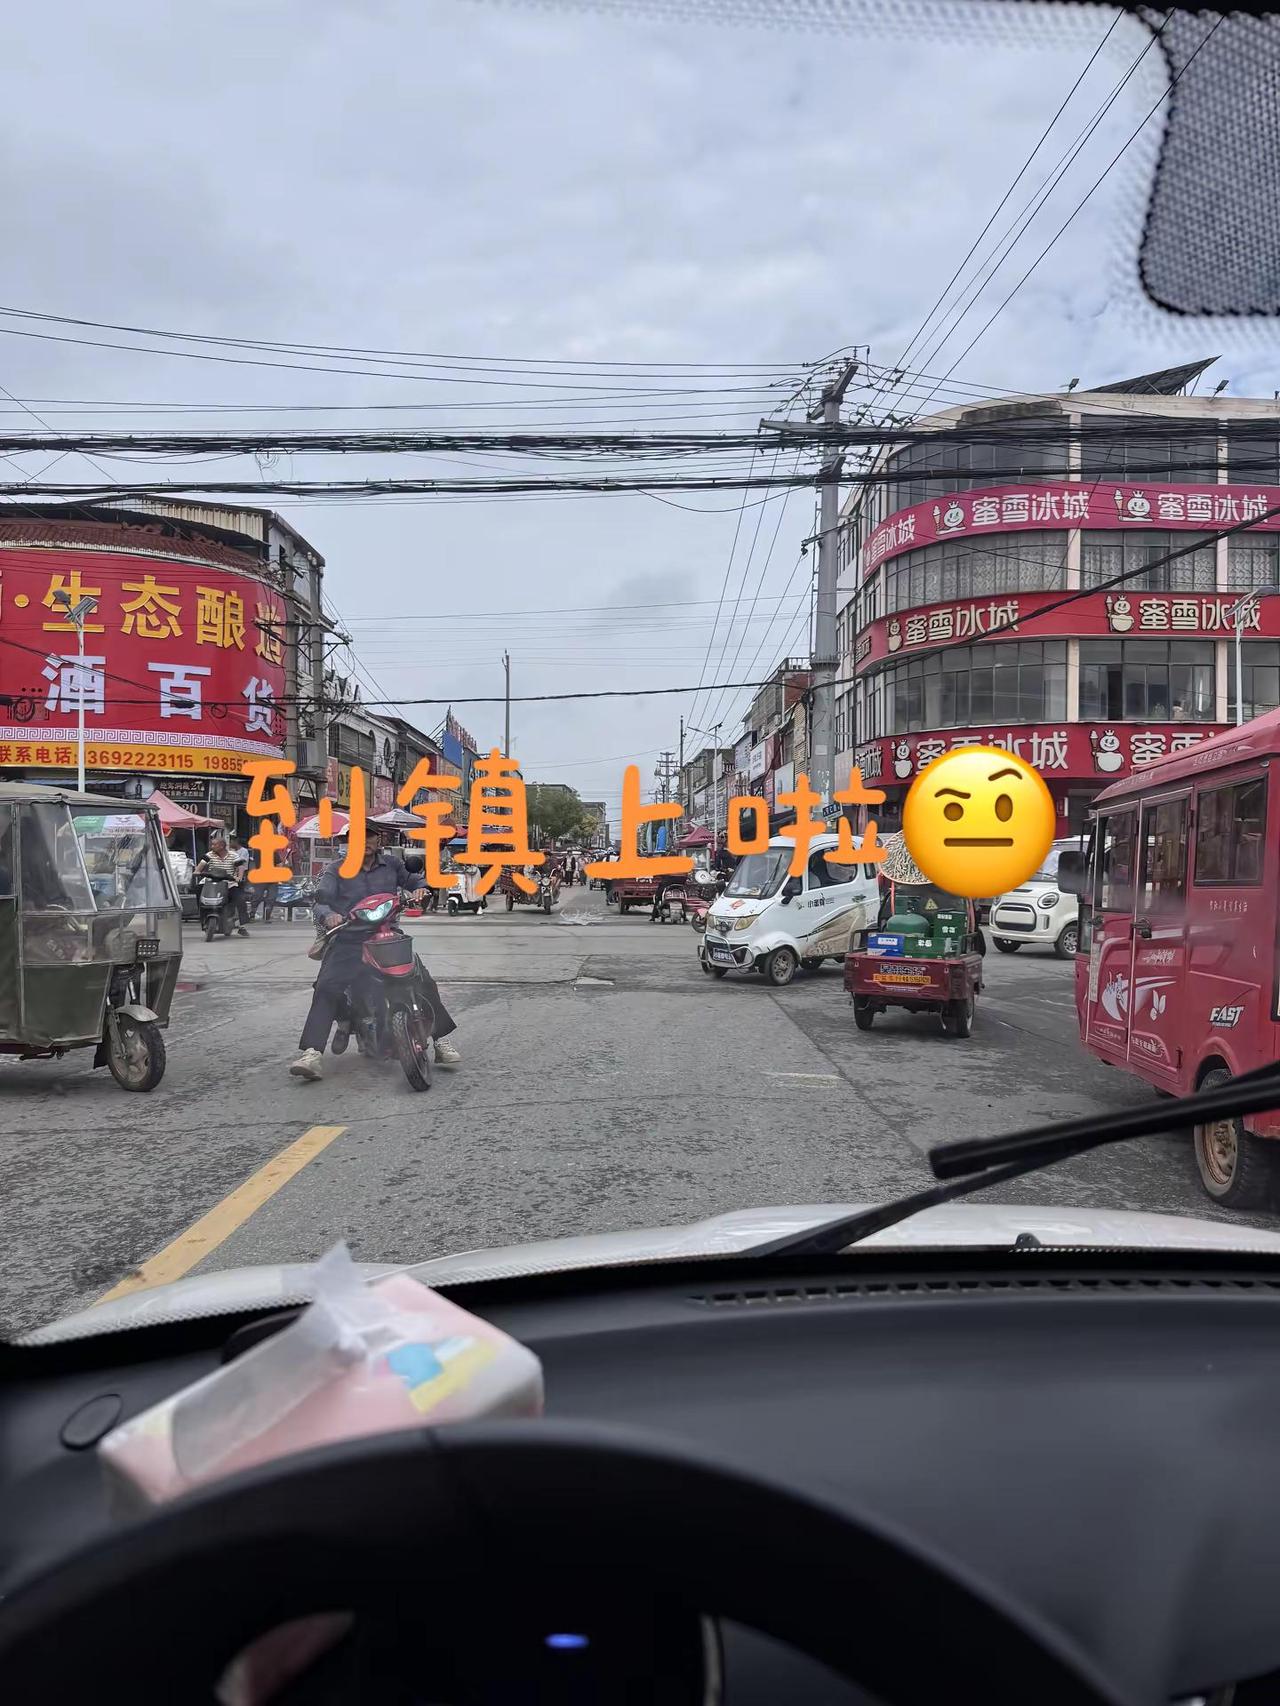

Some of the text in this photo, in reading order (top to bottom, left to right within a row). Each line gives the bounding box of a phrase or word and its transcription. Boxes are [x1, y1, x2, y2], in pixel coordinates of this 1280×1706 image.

[972, 490, 1090, 526] 蜜雪冰城
[1158, 492, 1268, 523] 蜜雪冰城
[904, 600, 1019, 645] 蜜雪冰城
[1138, 598, 1262, 631] 蜜雪冰城
[41, 652, 275, 738] 酒百货
[84, 750, 194, 769] 3692223115
[203, 755, 248, 772] 19855
[1209, 1005, 1245, 1027] FAST
